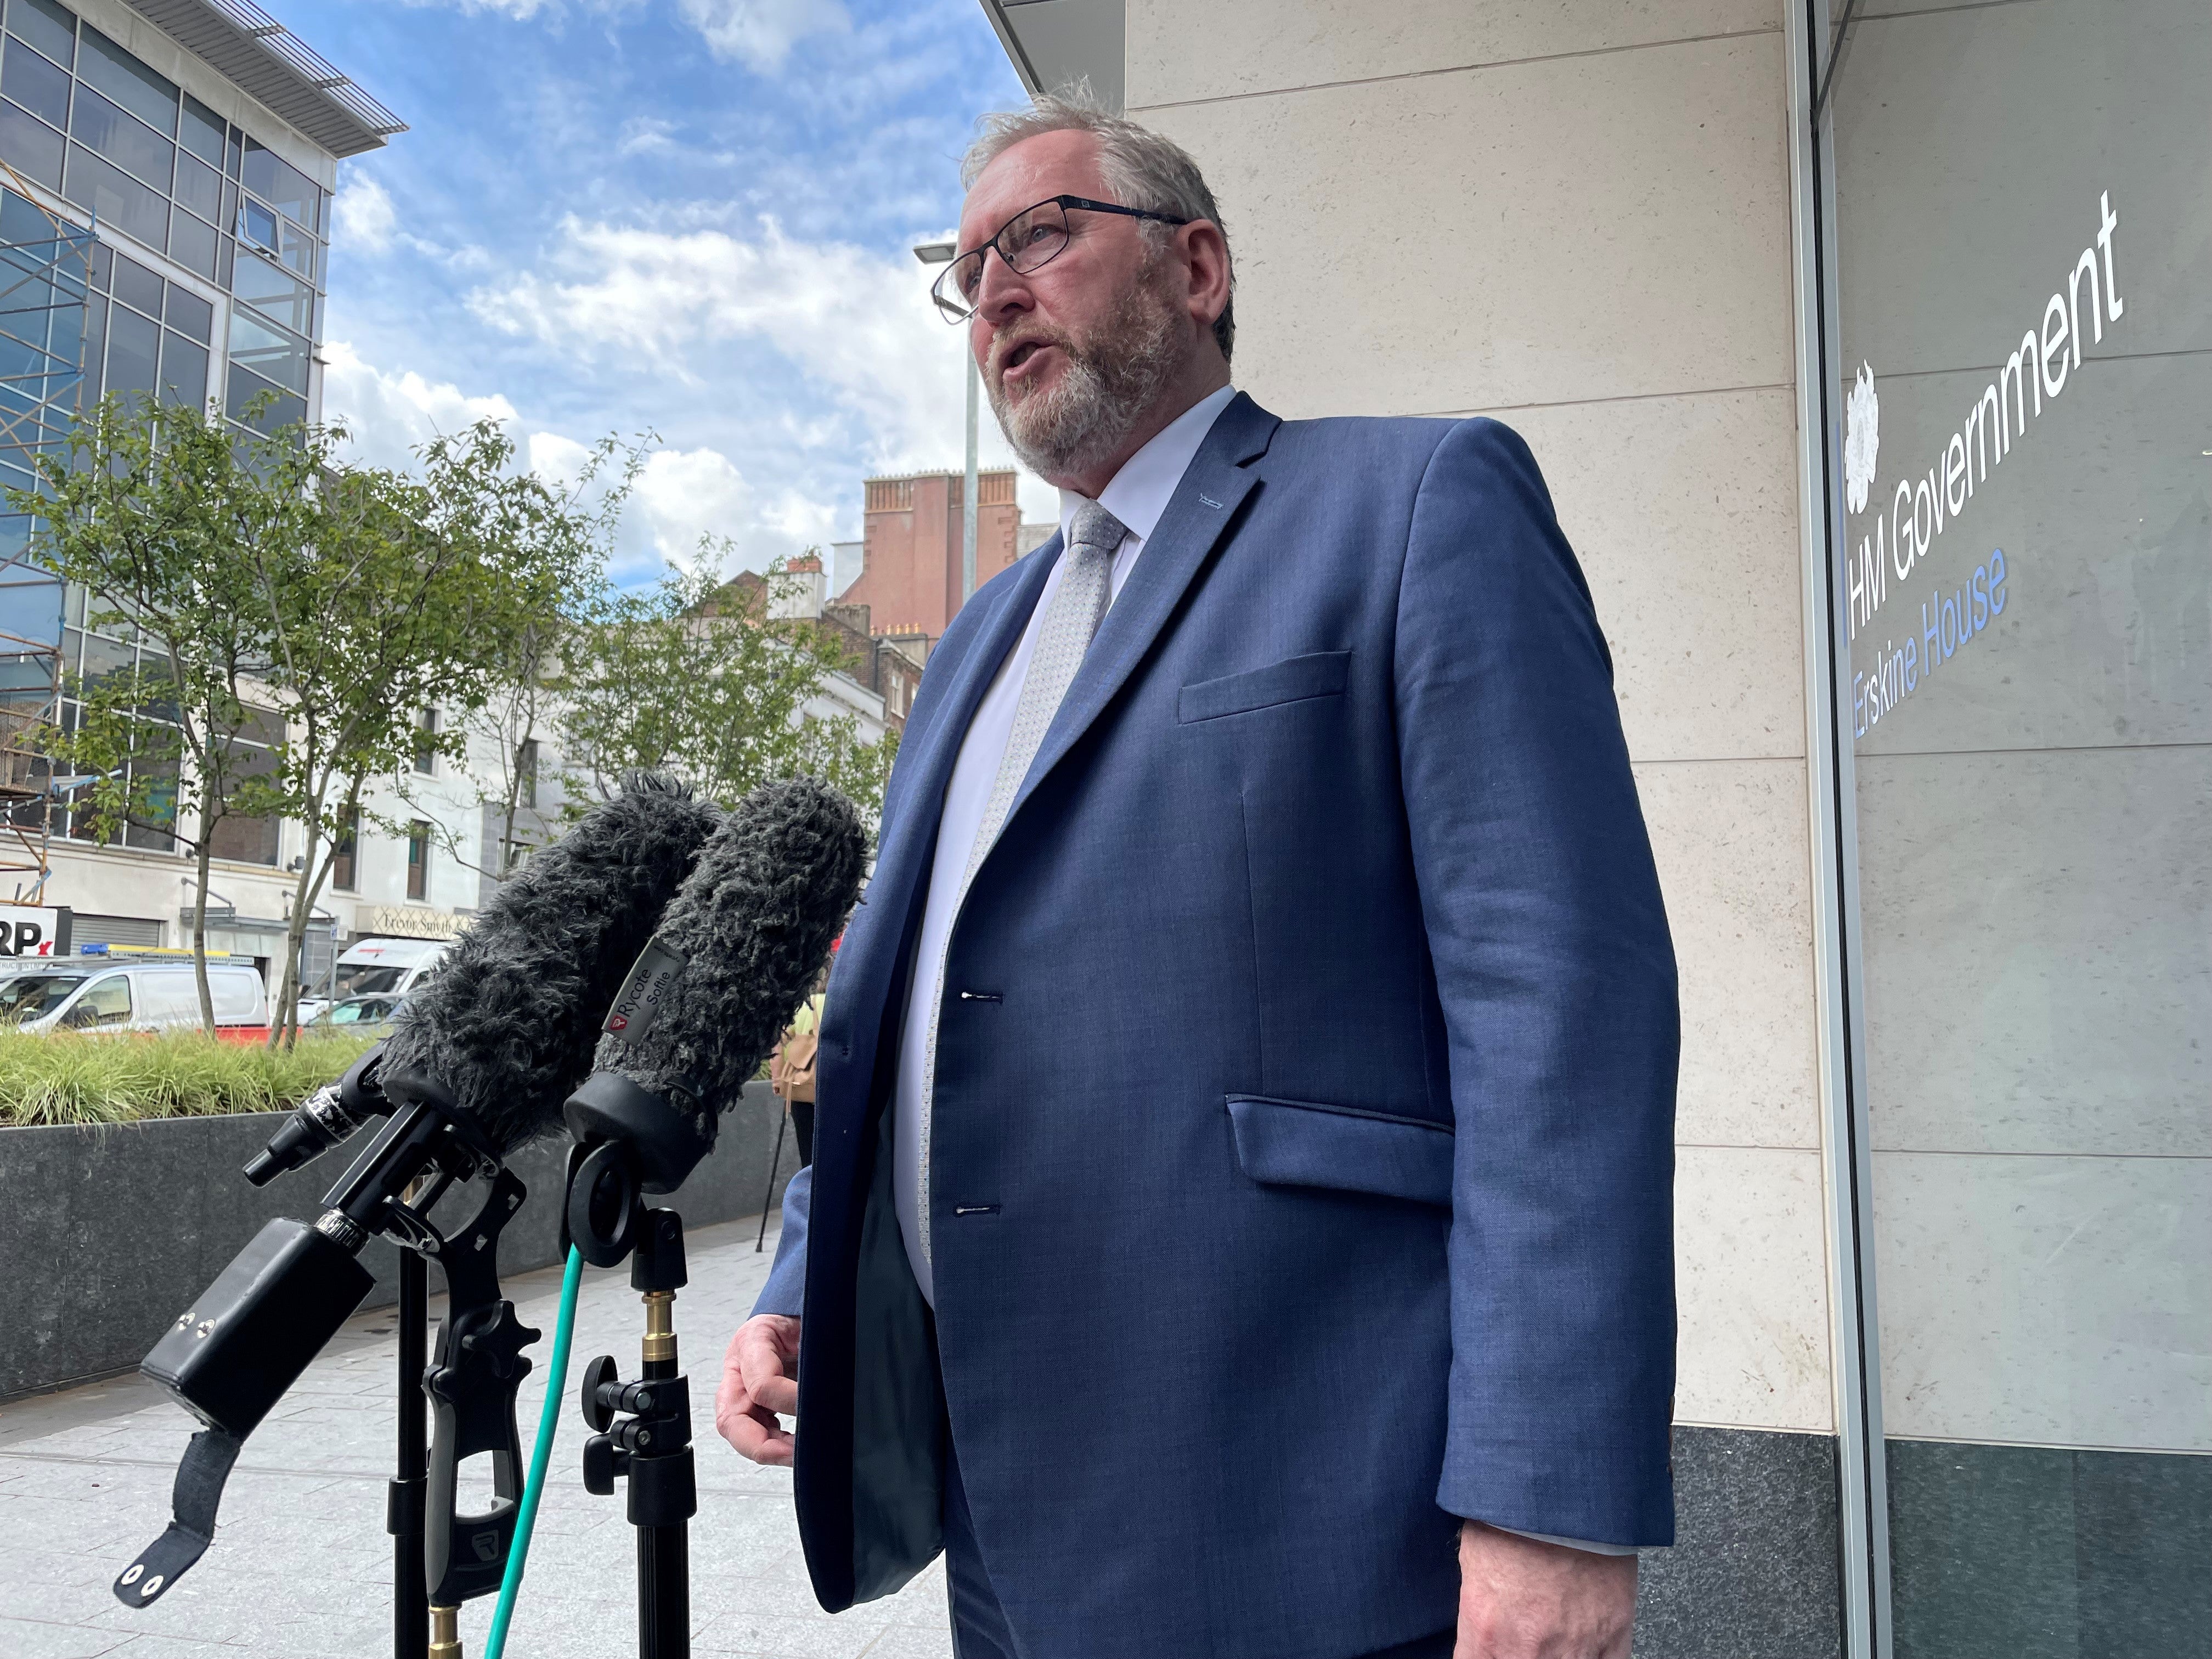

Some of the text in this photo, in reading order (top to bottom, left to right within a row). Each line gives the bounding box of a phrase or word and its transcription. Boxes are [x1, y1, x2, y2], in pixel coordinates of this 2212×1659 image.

[1849, 189, 2124, 640] HM Government
[1854, 548, 2005, 739] Erskine House
[385, 913, 417, 930] Trevor
[617, 969, 651, 1017] Rycote
[647, 972, 670, 1005] Softie
